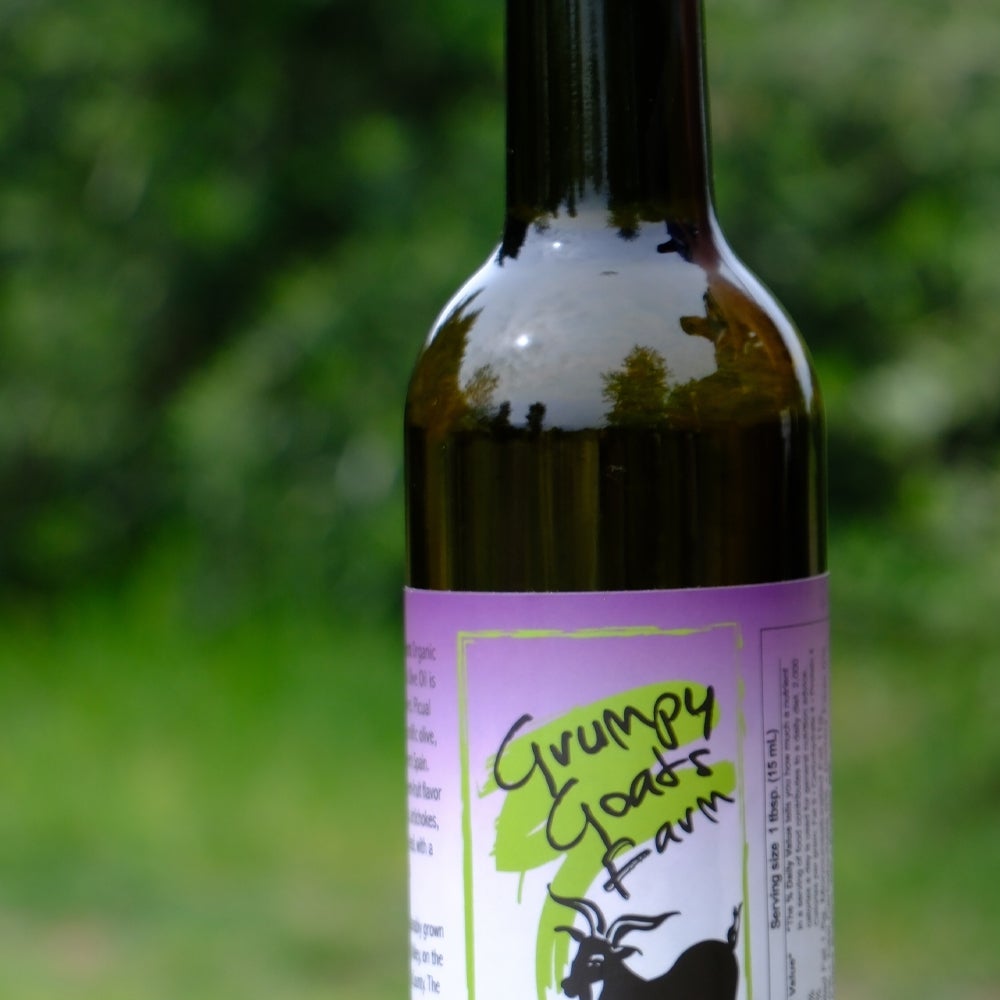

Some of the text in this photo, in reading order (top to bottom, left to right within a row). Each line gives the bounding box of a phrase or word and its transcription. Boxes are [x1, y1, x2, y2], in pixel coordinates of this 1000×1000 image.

[494, 685, 715, 798] Grumpy
[767, 729, 779, 757] mL)
[768, 760, 779, 783] (15
[546, 747, 713, 857] Goats
[768, 786, 779, 823] tbsp.
[602, 789, 735, 900] Farm
[769, 842, 779, 871] size
[770, 874, 782, 929] Serving
[423, 923, 444, 940] grown
[431, 950, 444, 967] the
[427, 975, 440, 994] The
